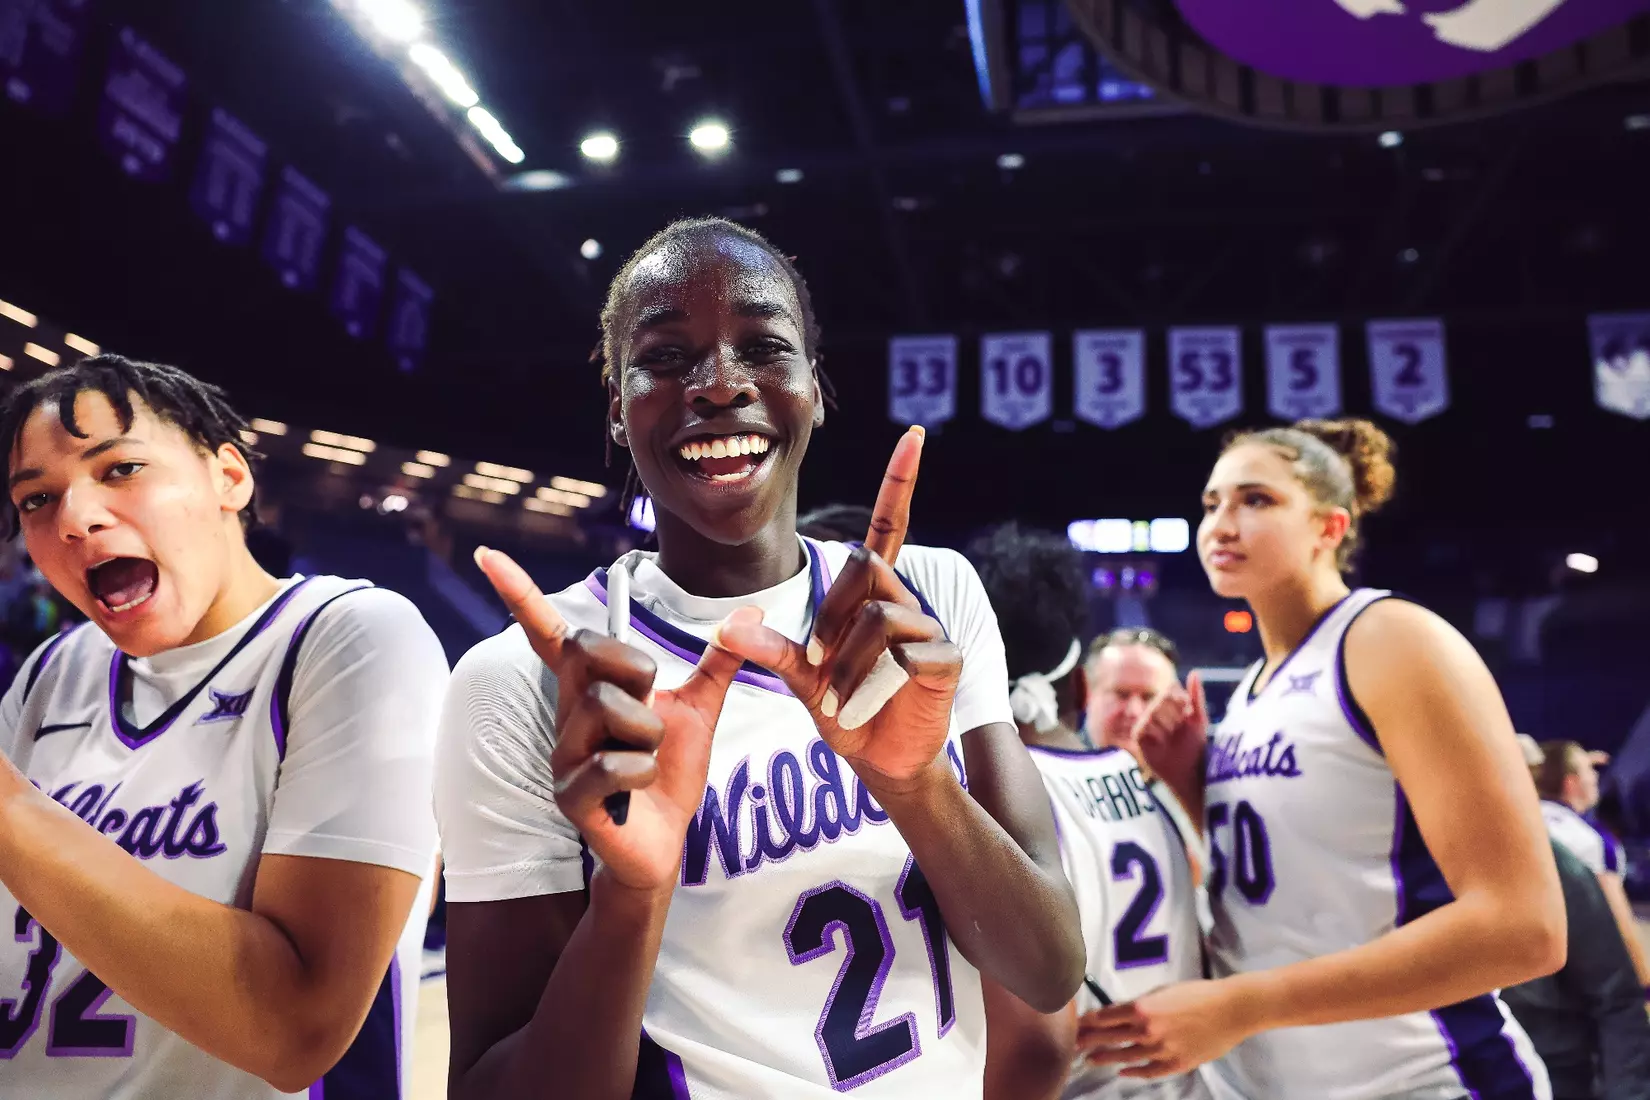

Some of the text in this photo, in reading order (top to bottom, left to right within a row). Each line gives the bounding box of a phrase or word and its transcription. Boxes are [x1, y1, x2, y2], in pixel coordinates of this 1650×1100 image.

[893, 357, 947, 396] 33
[991, 356, 1042, 396] 10
[1096, 353, 1123, 394] 3
[1178, 351, 1232, 392] 53
[1288, 349, 1318, 391] 5
[1393, 345, 1425, 388] 2
[1111, 841, 1168, 970] 2
[782, 852, 956, 1093] 21
